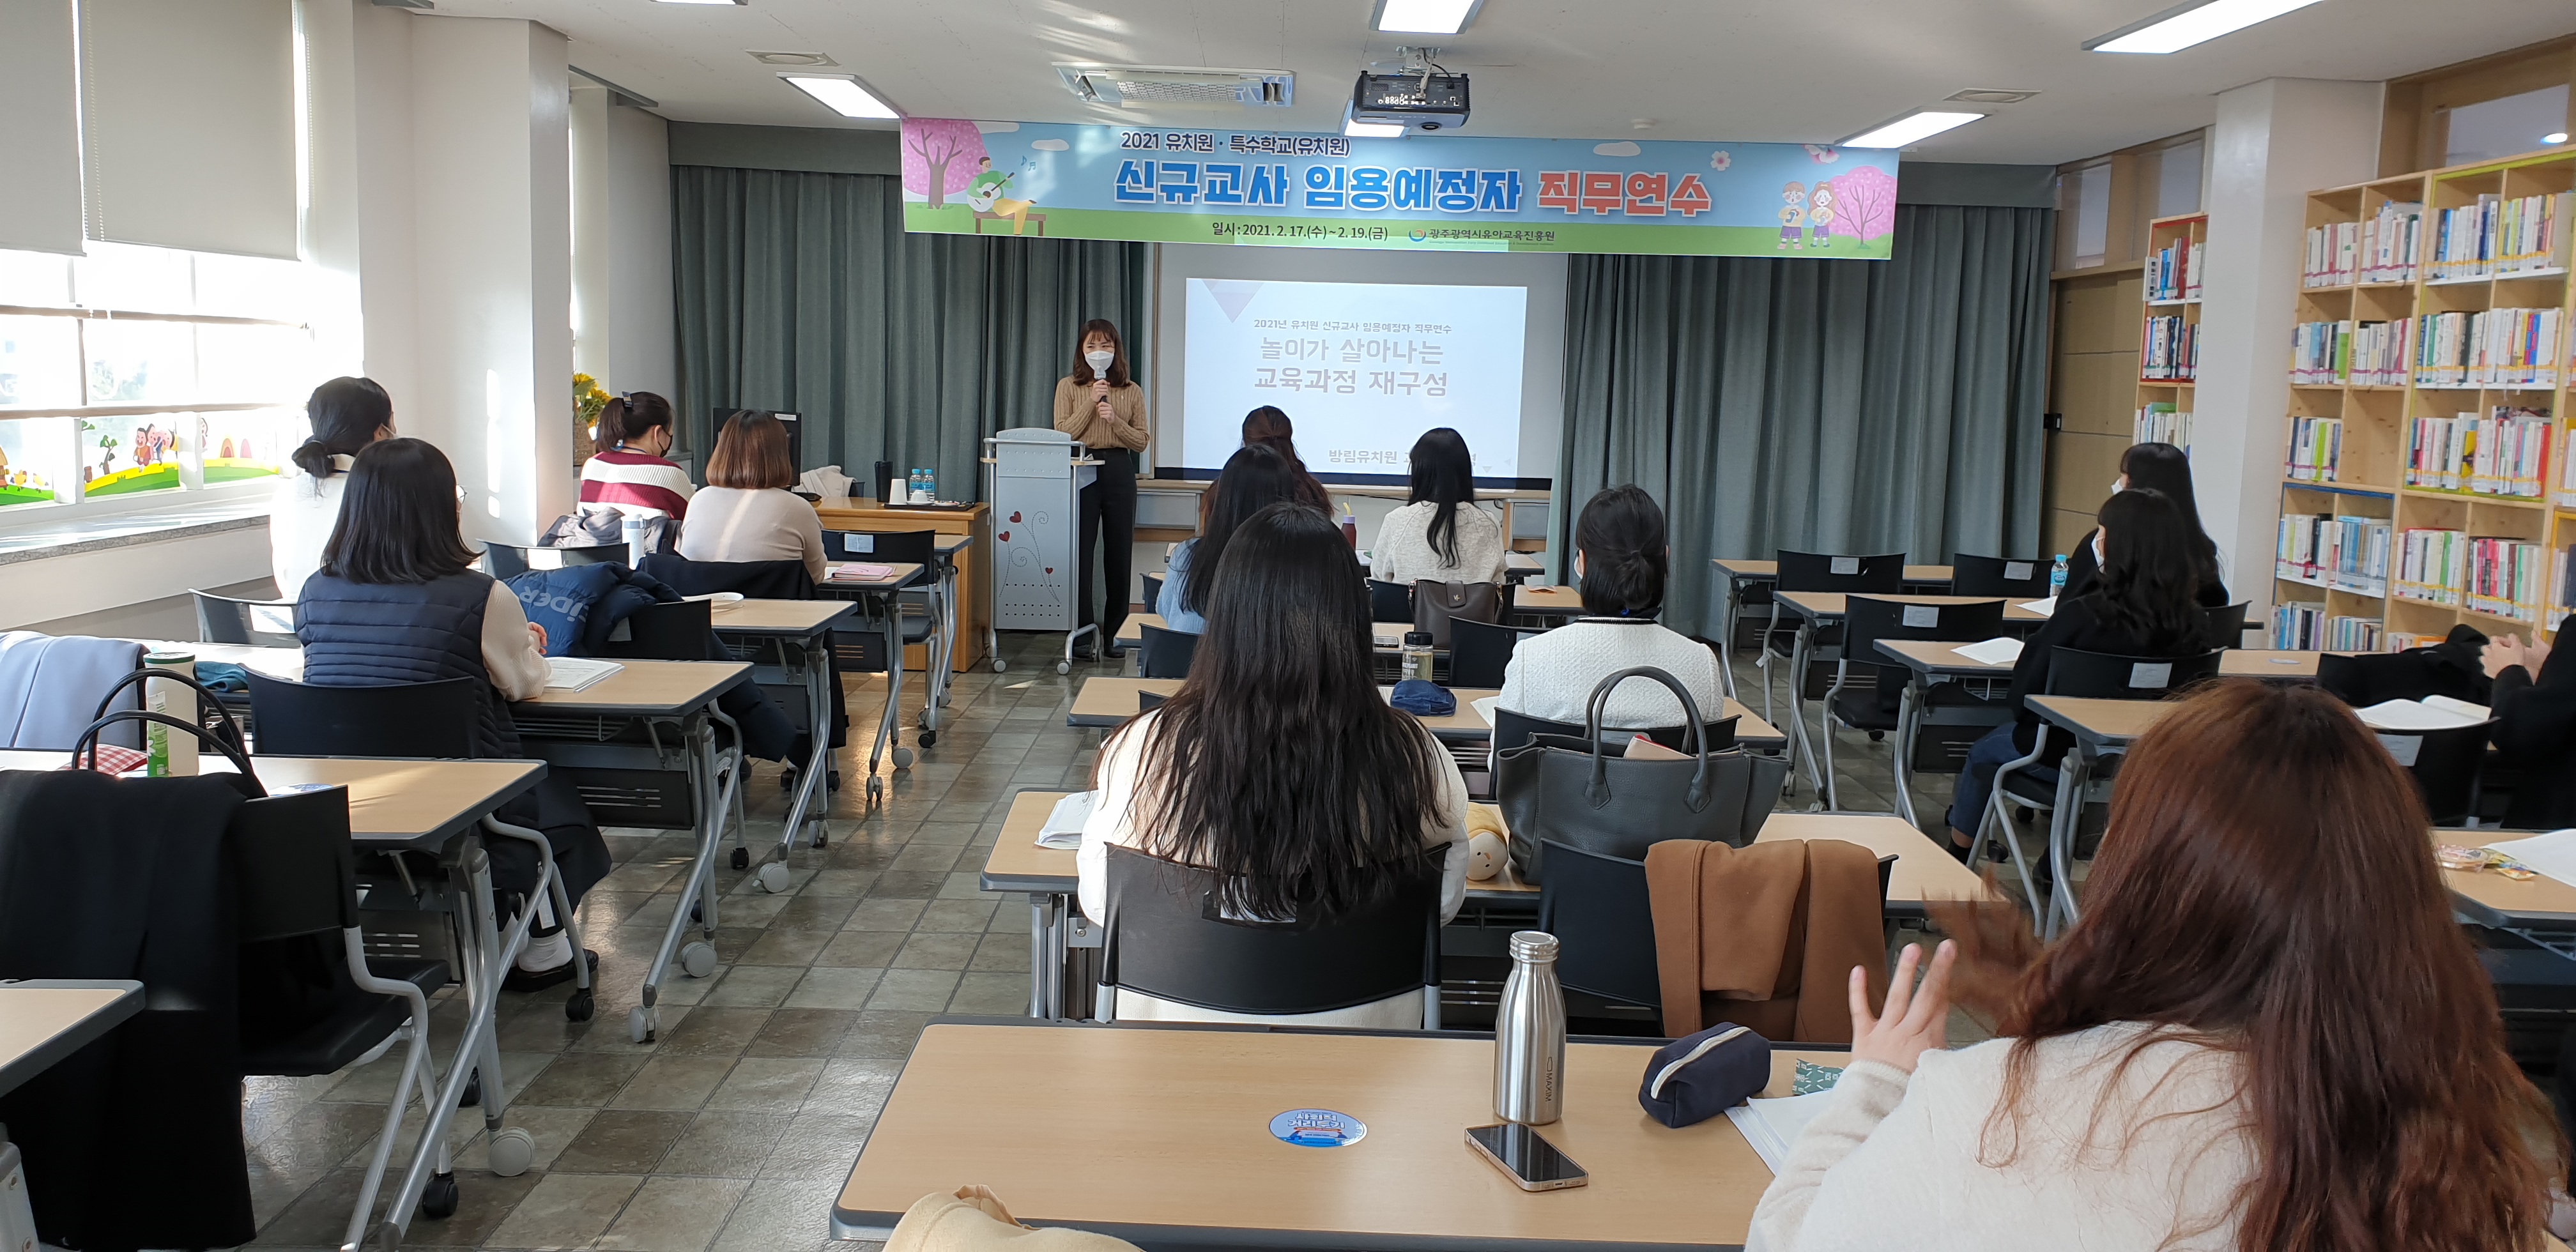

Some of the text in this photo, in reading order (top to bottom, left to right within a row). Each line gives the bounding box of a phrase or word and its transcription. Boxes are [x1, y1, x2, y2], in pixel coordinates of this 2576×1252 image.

[1121, 132, 1160, 149] 2021
[1165, 133, 1213, 153] 유치원
[1230, 135, 1351, 156] 특수학교(유치원)
[1114, 159, 1712, 217] 신규교사 임용예정자 직무연수
[1429, 229, 1555, 241] 광주광역시유아교육진흥원
[1254, 319, 1452, 334] 2021년 유치원 신규교사 임용예정자 직무연수
[1261, 337, 1444, 365] 놀이가 살아나는
[1254, 367, 1447, 397] 교육과정 재구성
[1328, 450, 1398, 464] 방림유치원
[519, 586, 589, 623] iDER
[1545, 1073, 1553, 1102] MAXIM
[1288, 1119, 1346, 1129] 거리두기
